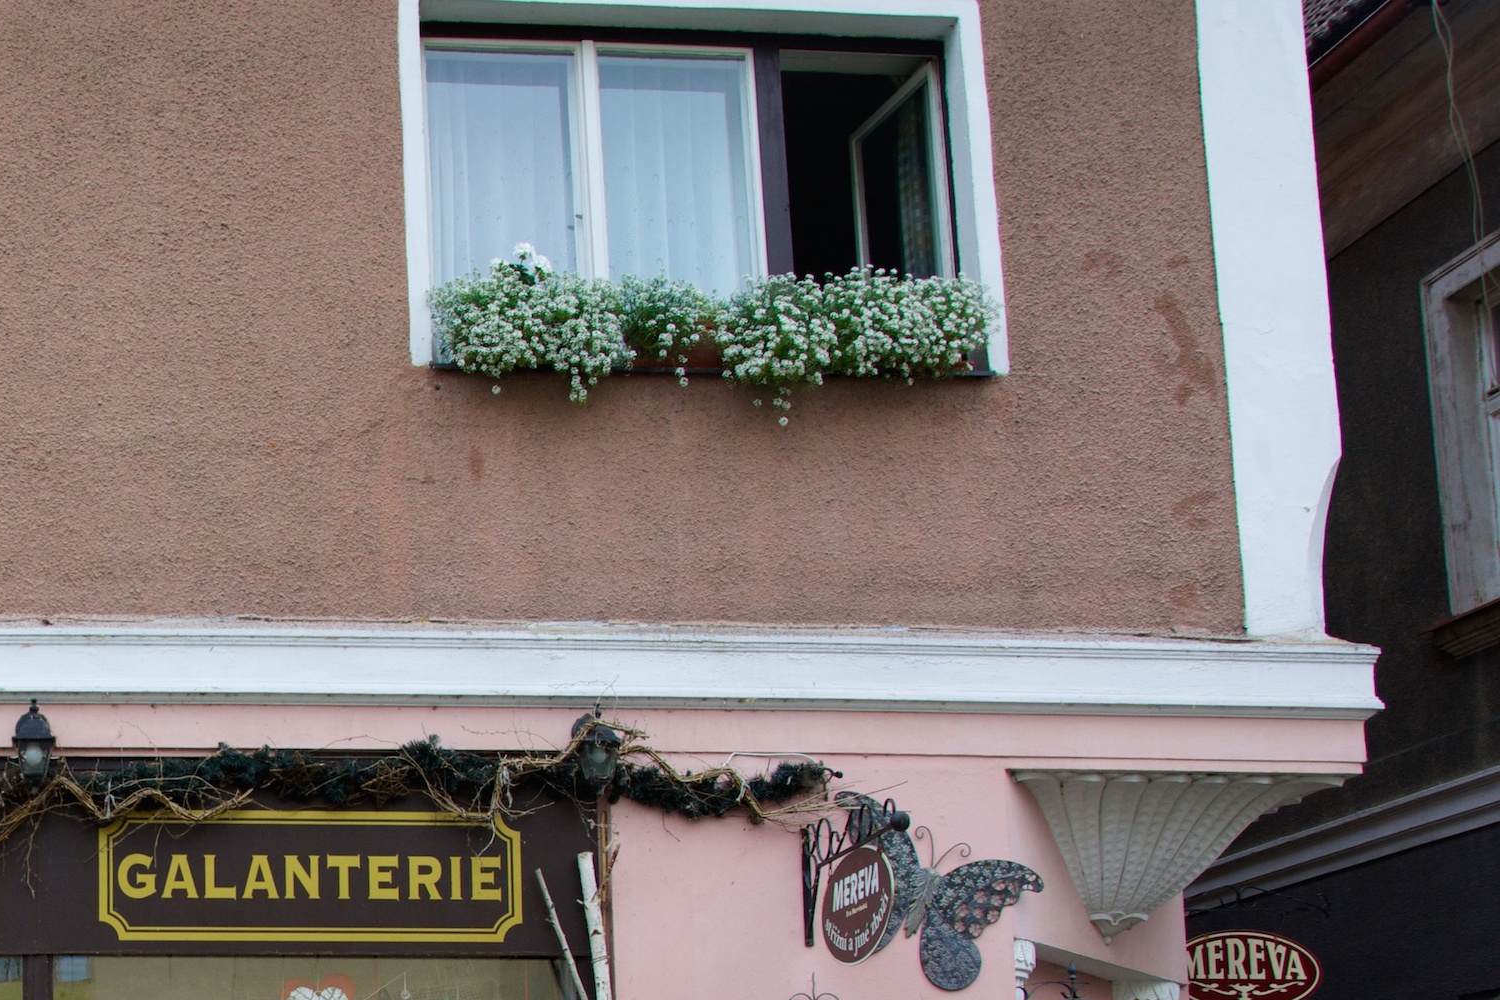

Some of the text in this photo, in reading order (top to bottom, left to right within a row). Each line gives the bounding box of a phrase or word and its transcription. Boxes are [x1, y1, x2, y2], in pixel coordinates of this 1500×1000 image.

[117, 852, 502, 902] GALANTERIE
[832, 861, 880, 913] MEREVA
[848, 937, 854, 951] a
[853, 922, 870, 957] jiné
[1186, 938, 1307, 980] MEREVA
